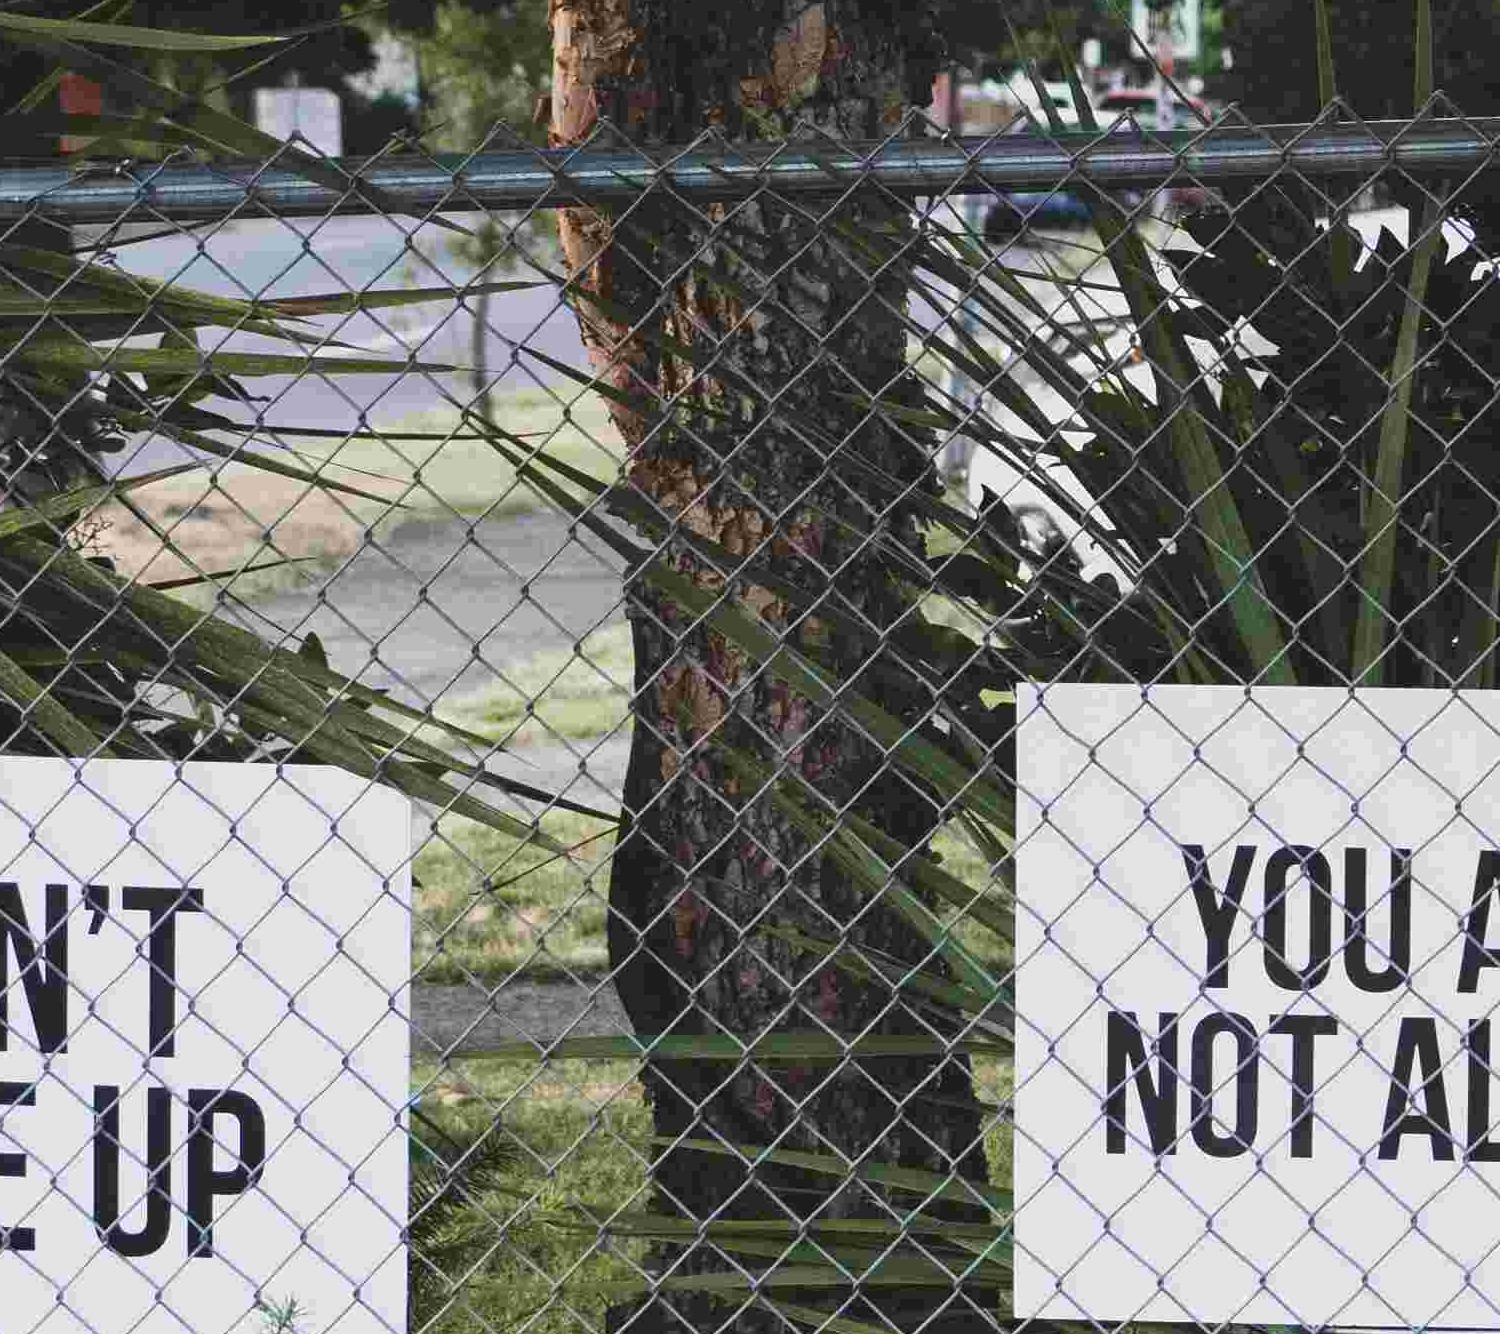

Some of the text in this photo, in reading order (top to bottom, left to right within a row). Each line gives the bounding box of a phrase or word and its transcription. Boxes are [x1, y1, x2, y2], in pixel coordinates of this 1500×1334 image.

[1182, 844, 1412, 993] YOU
[1105, 1010, 1338, 1159] NOT
[93, 1084, 267, 1259] UP
